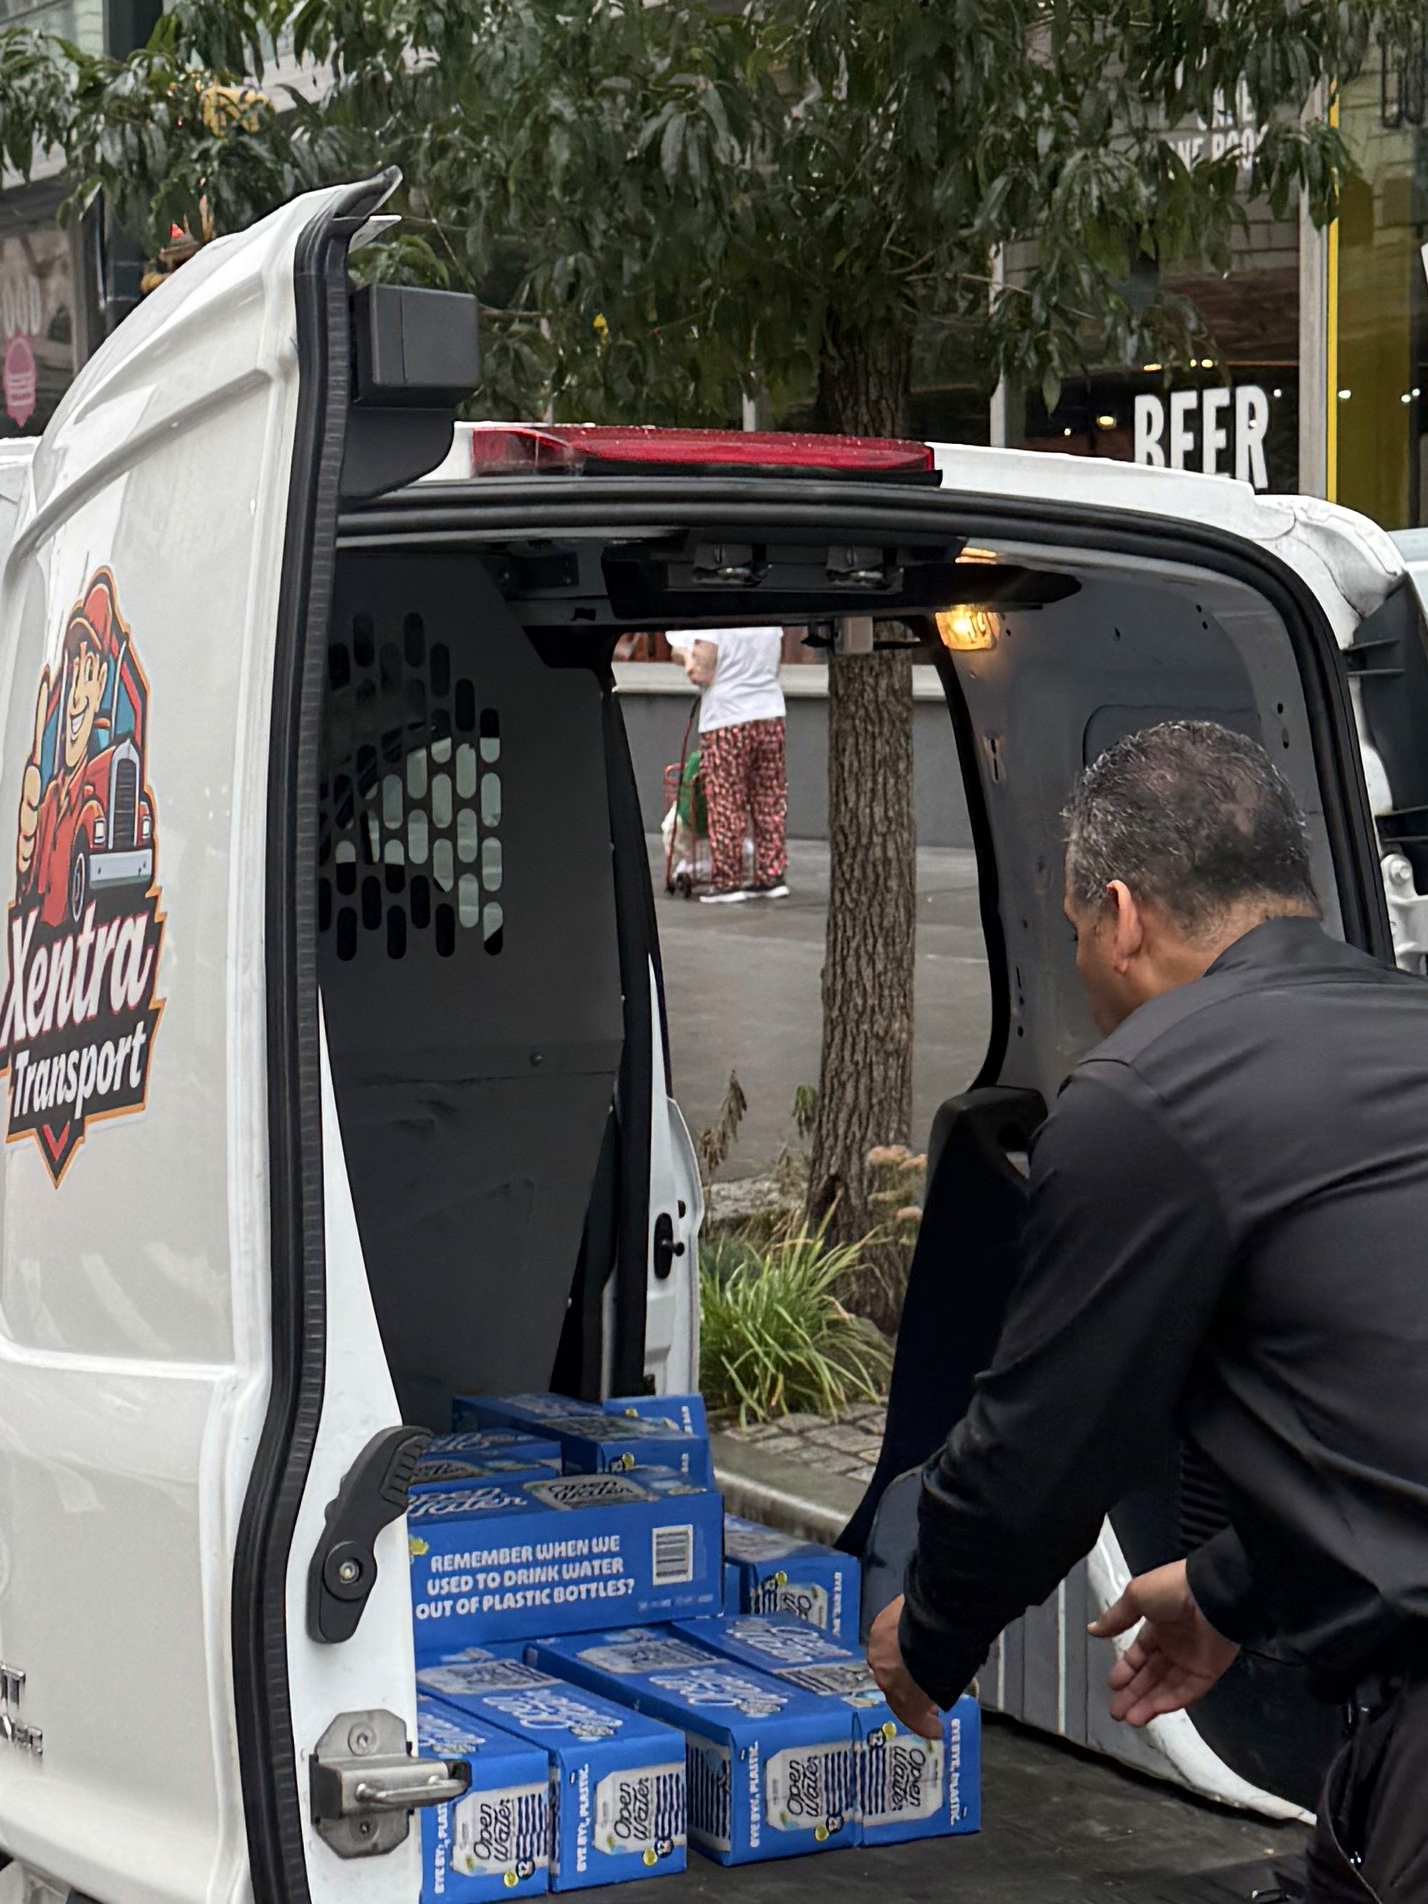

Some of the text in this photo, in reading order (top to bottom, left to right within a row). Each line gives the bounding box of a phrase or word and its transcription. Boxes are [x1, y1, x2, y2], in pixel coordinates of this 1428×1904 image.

[1134, 385, 1269, 489] BEER
[12, 1020, 148, 1119] Transport
[426, 1557, 624, 1597] USED TO DRINK WATER
[430, 1535, 621, 1573] REMEMBER WHEN WE
[415, 1598, 454, 1621] OUT
[455, 1596, 480, 1616] OF
[482, 1588, 552, 1613] PLASTIC
[553, 1577, 636, 1603] BOTTLES?
[786, 1758, 804, 1816] Open
[805, 1754, 821, 1818] Water
[892, 1745, 909, 1812] Water
[909, 1747, 926, 1808] Open
[473, 1802, 496, 1860] Open
[493, 1798, 513, 1862] Water
[613, 1782, 632, 1839] Open
[632, 1777, 650, 1841] Water
